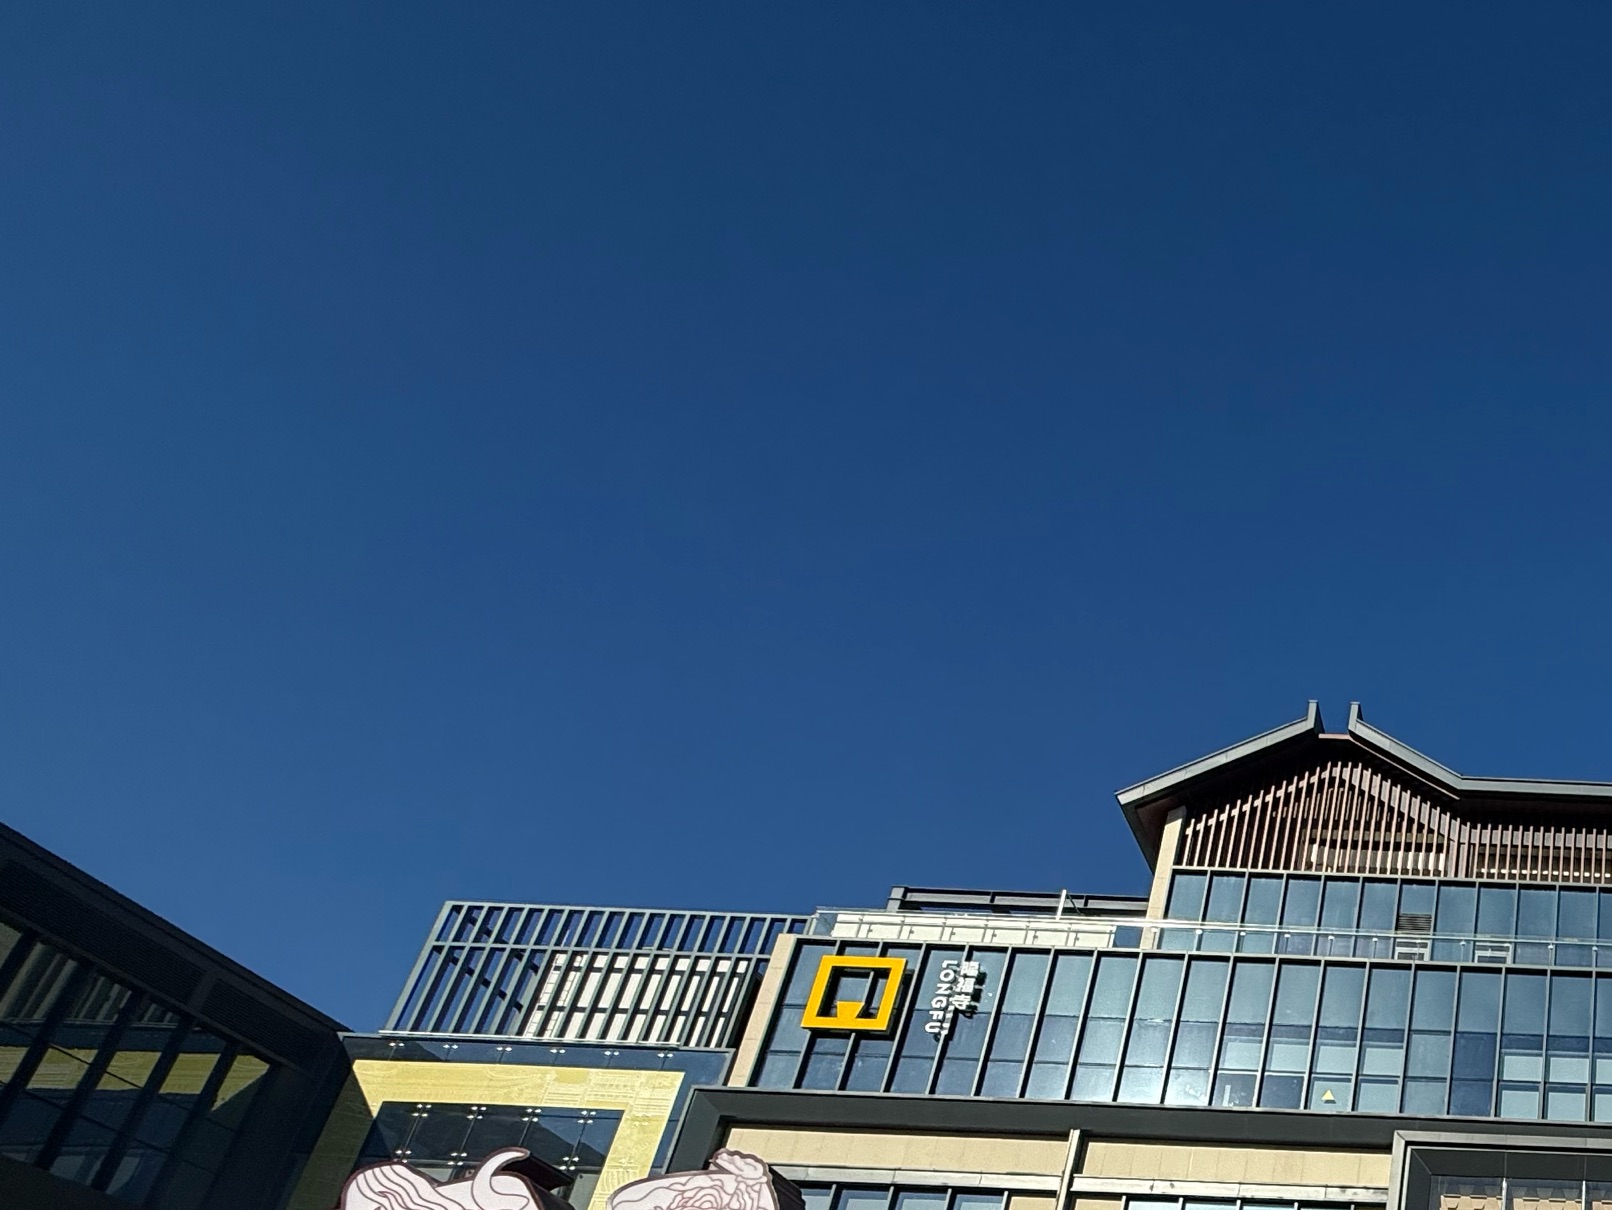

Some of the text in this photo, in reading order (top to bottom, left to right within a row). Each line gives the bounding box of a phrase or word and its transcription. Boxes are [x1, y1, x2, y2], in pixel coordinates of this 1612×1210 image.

[924, 960, 958, 1034] LONGFU
[949, 960, 980, 1011] 隆福寺
